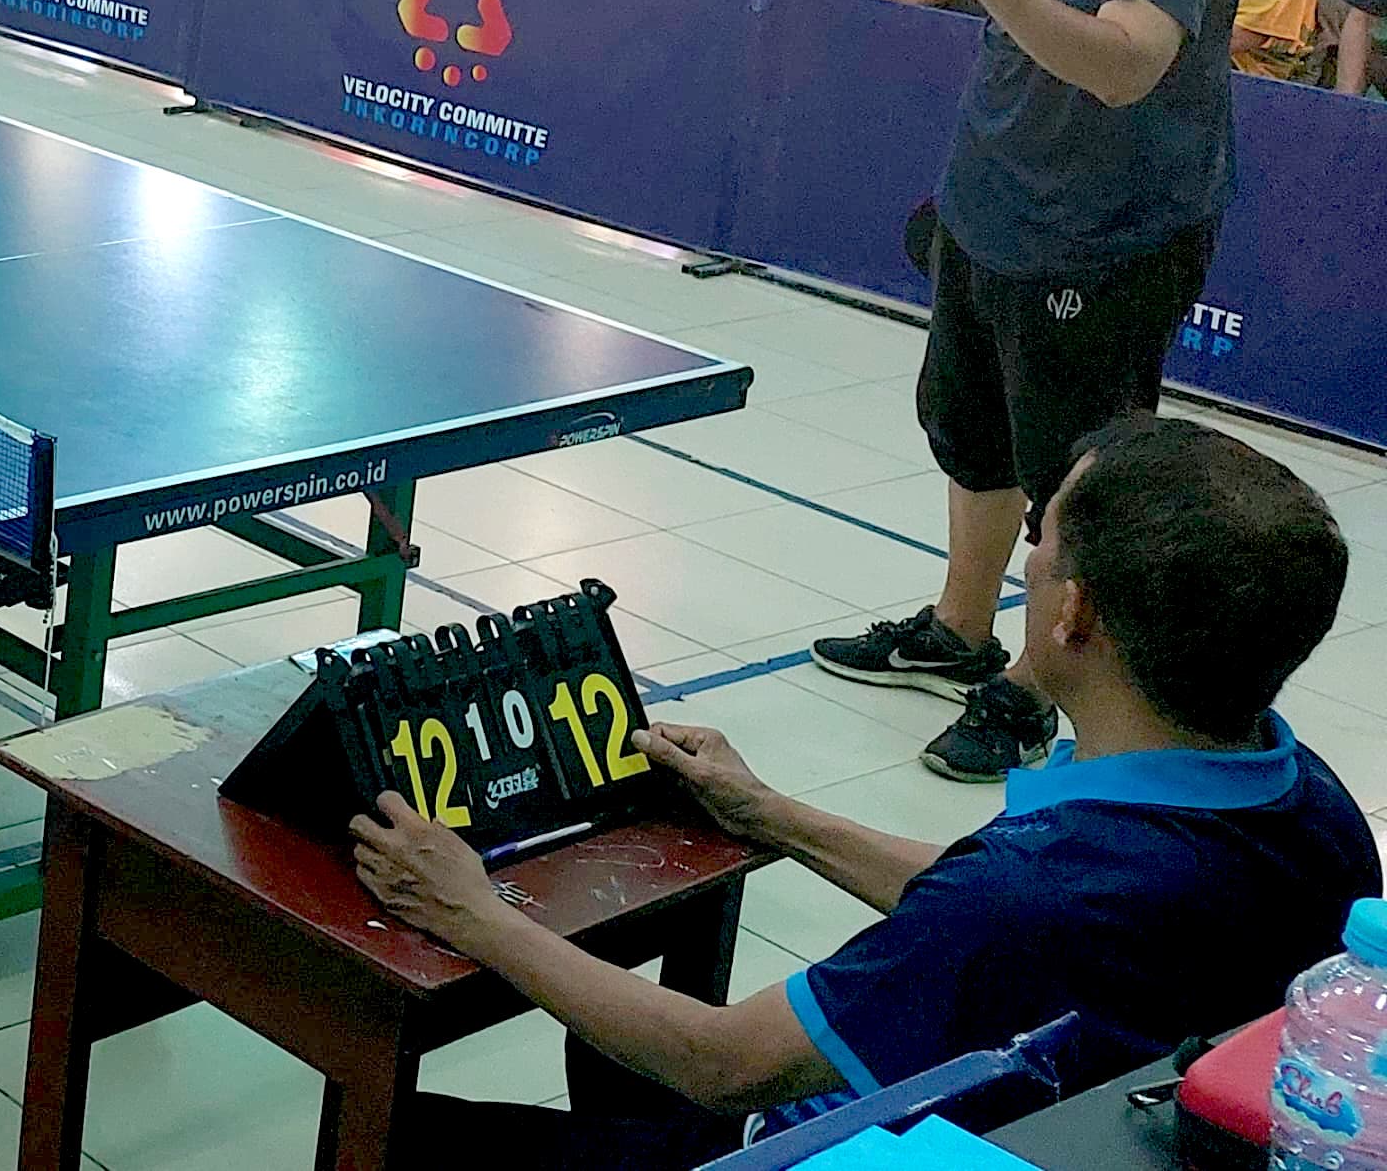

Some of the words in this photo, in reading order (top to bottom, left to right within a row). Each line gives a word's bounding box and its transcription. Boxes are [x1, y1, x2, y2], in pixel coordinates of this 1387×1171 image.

[341, 95, 540, 166] INKORINCORP
[342, 75, 436, 116] VELOCITY
[438, 101, 549, 148] COMMITTE
[144, 460, 387, 532] www.powerspin.co.id
[391, 718, 472, 828] 12
[465, 702, 492, 761] 1
[502, 689, 534, 749] 0
[548, 673, 652, 788] 12
